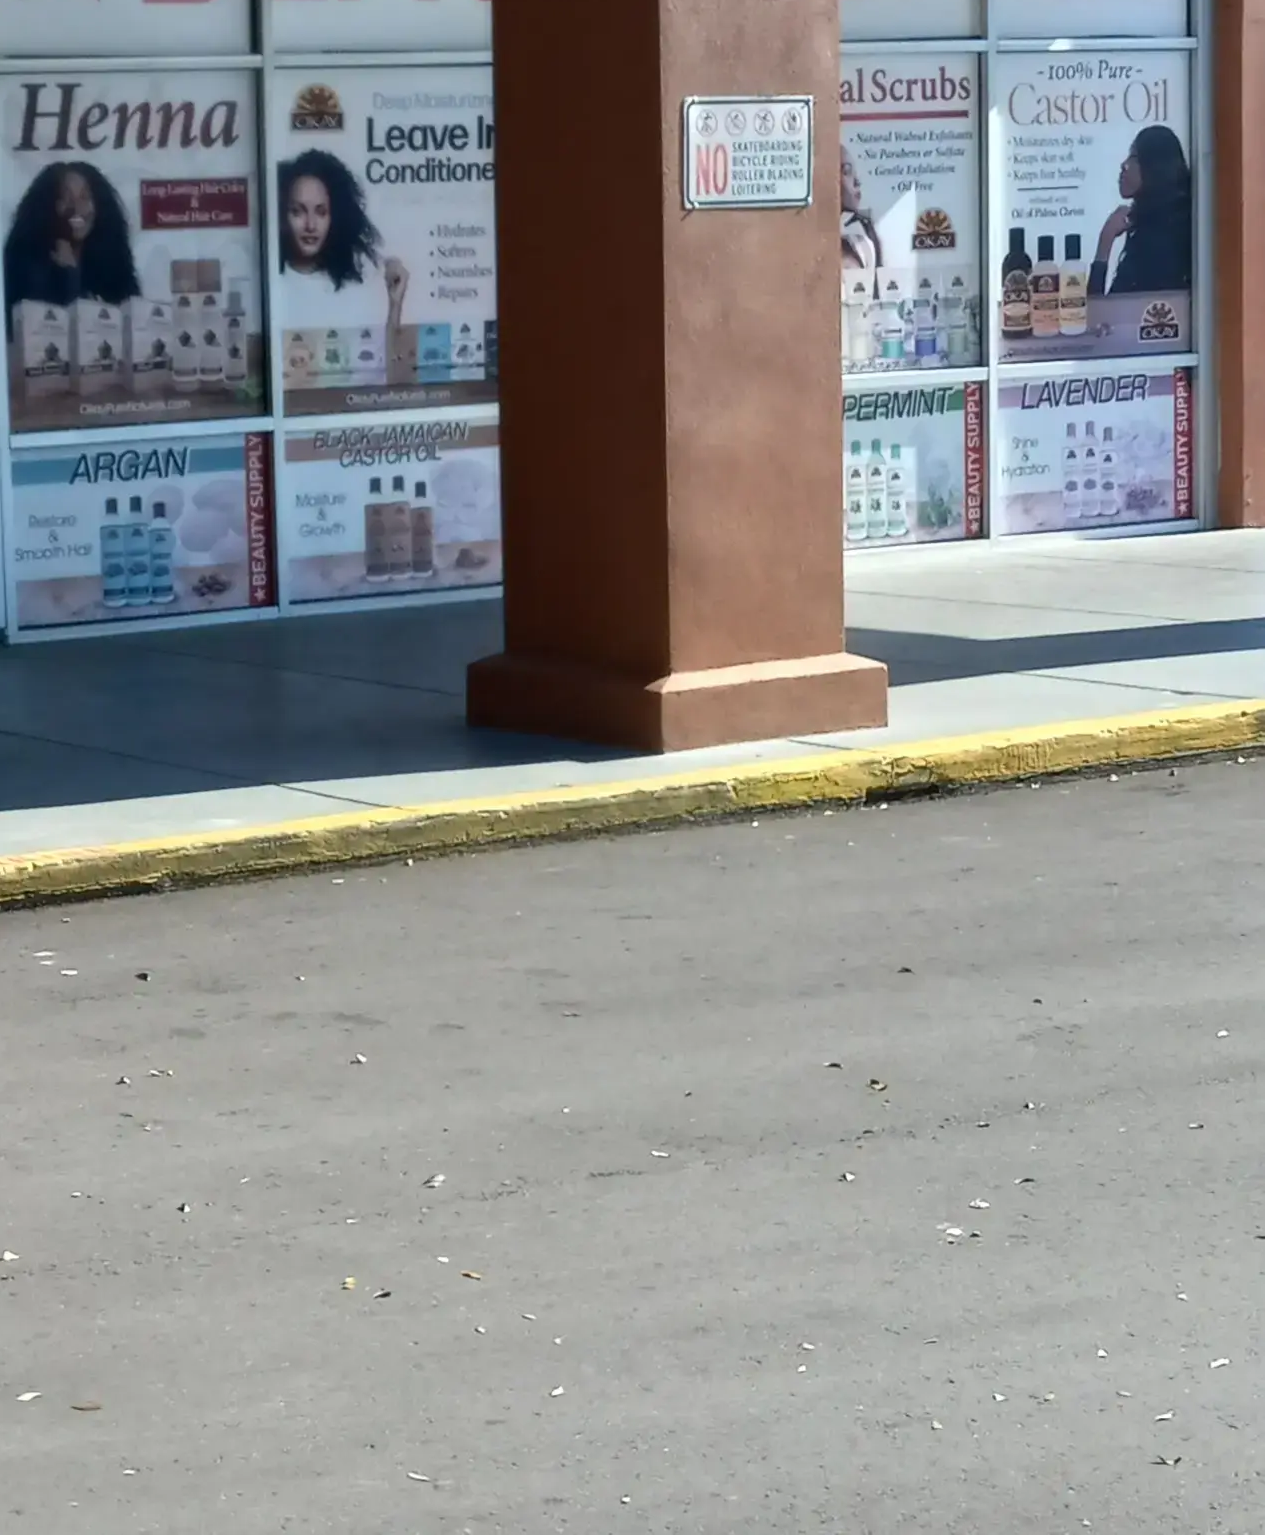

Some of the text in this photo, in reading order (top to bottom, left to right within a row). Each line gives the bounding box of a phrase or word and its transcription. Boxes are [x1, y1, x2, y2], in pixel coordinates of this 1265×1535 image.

[870, 66, 972, 103] Scrubs
[1047, 59, 1133, 81] 100% Pure
[12, 82, 240, 152] Henna
[1008, 78, 1168, 126] Castor Oil
[366, 117, 469, 152] Leave
[732, 140, 803, 153] SKATEBOARDING
[366, 157, 495, 185] Conditione
[696, 143, 728, 196] NO
[731, 183, 777, 196] LOITERING
[915, 235, 954, 248] OKAY
[842, 386, 954, 421] PERMINT
[1020, 373, 1149, 410] LAVENDER
[314, 422, 469, 450] BLACK JAMAICAN
[967, 382, 981, 520] BEAUTY SUPPLY
[69, 446, 189, 485] ARGAN
[339, 444, 442, 468] CASTOR OIL
[1176, 433, 1190, 500] BEAUTY
[246, 435, 268, 587] BEAUTY SUPPLY
